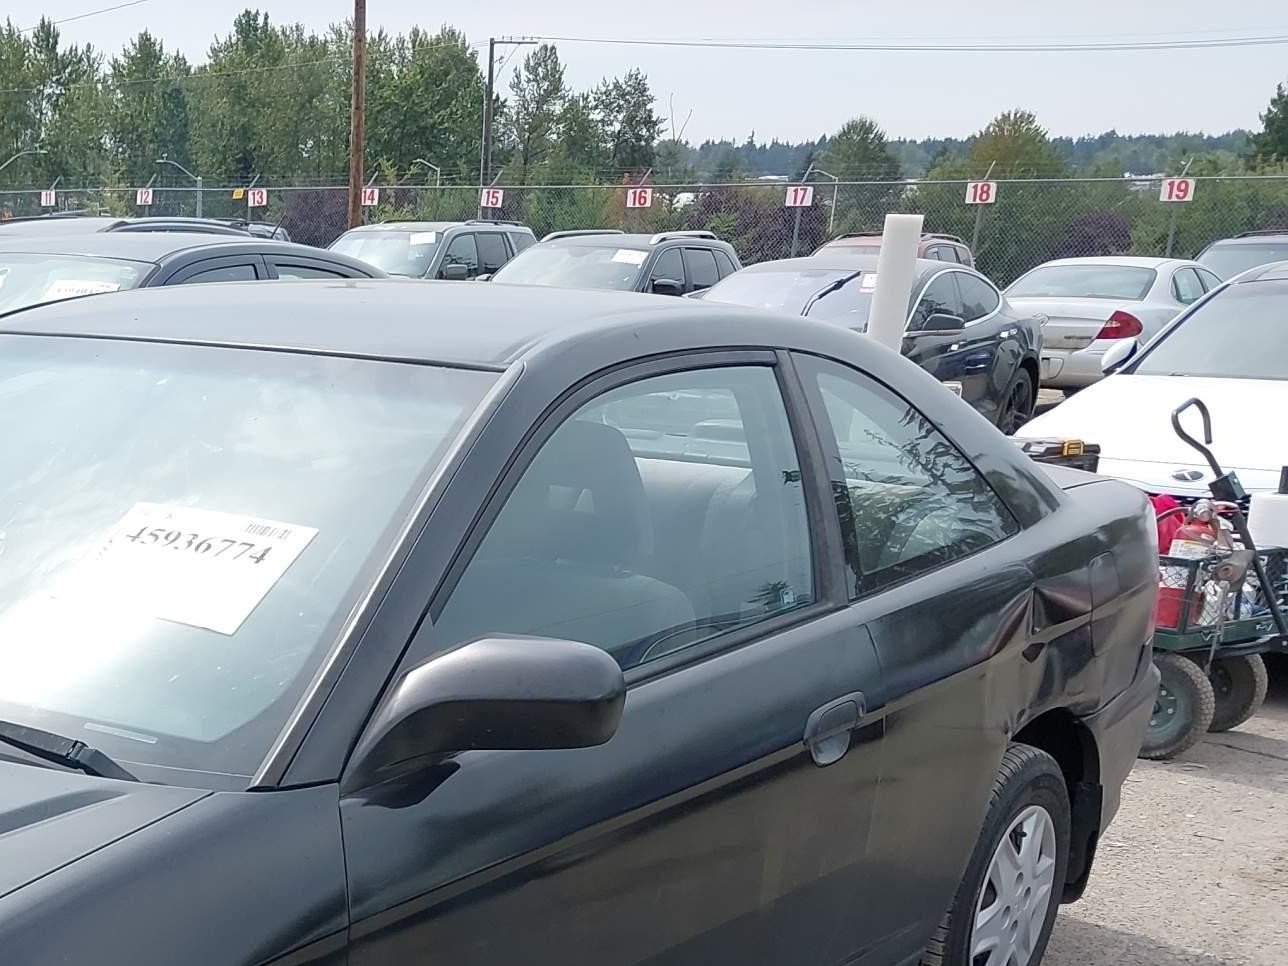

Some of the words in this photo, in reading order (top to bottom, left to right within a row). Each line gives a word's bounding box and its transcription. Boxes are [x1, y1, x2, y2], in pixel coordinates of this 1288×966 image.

[140, 190, 150, 204] 12
[251, 190, 264, 205] 13
[362, 190, 375, 204] 14
[485, 190, 500, 206] 15
[631, 190, 647, 206] 16
[792, 188, 808, 205] 17
[972, 183, 991, 203] 18
[1167, 180, 1190, 200] 19
[45, 192, 52, 205] 11
[126, 526, 273, 564] 45936774
